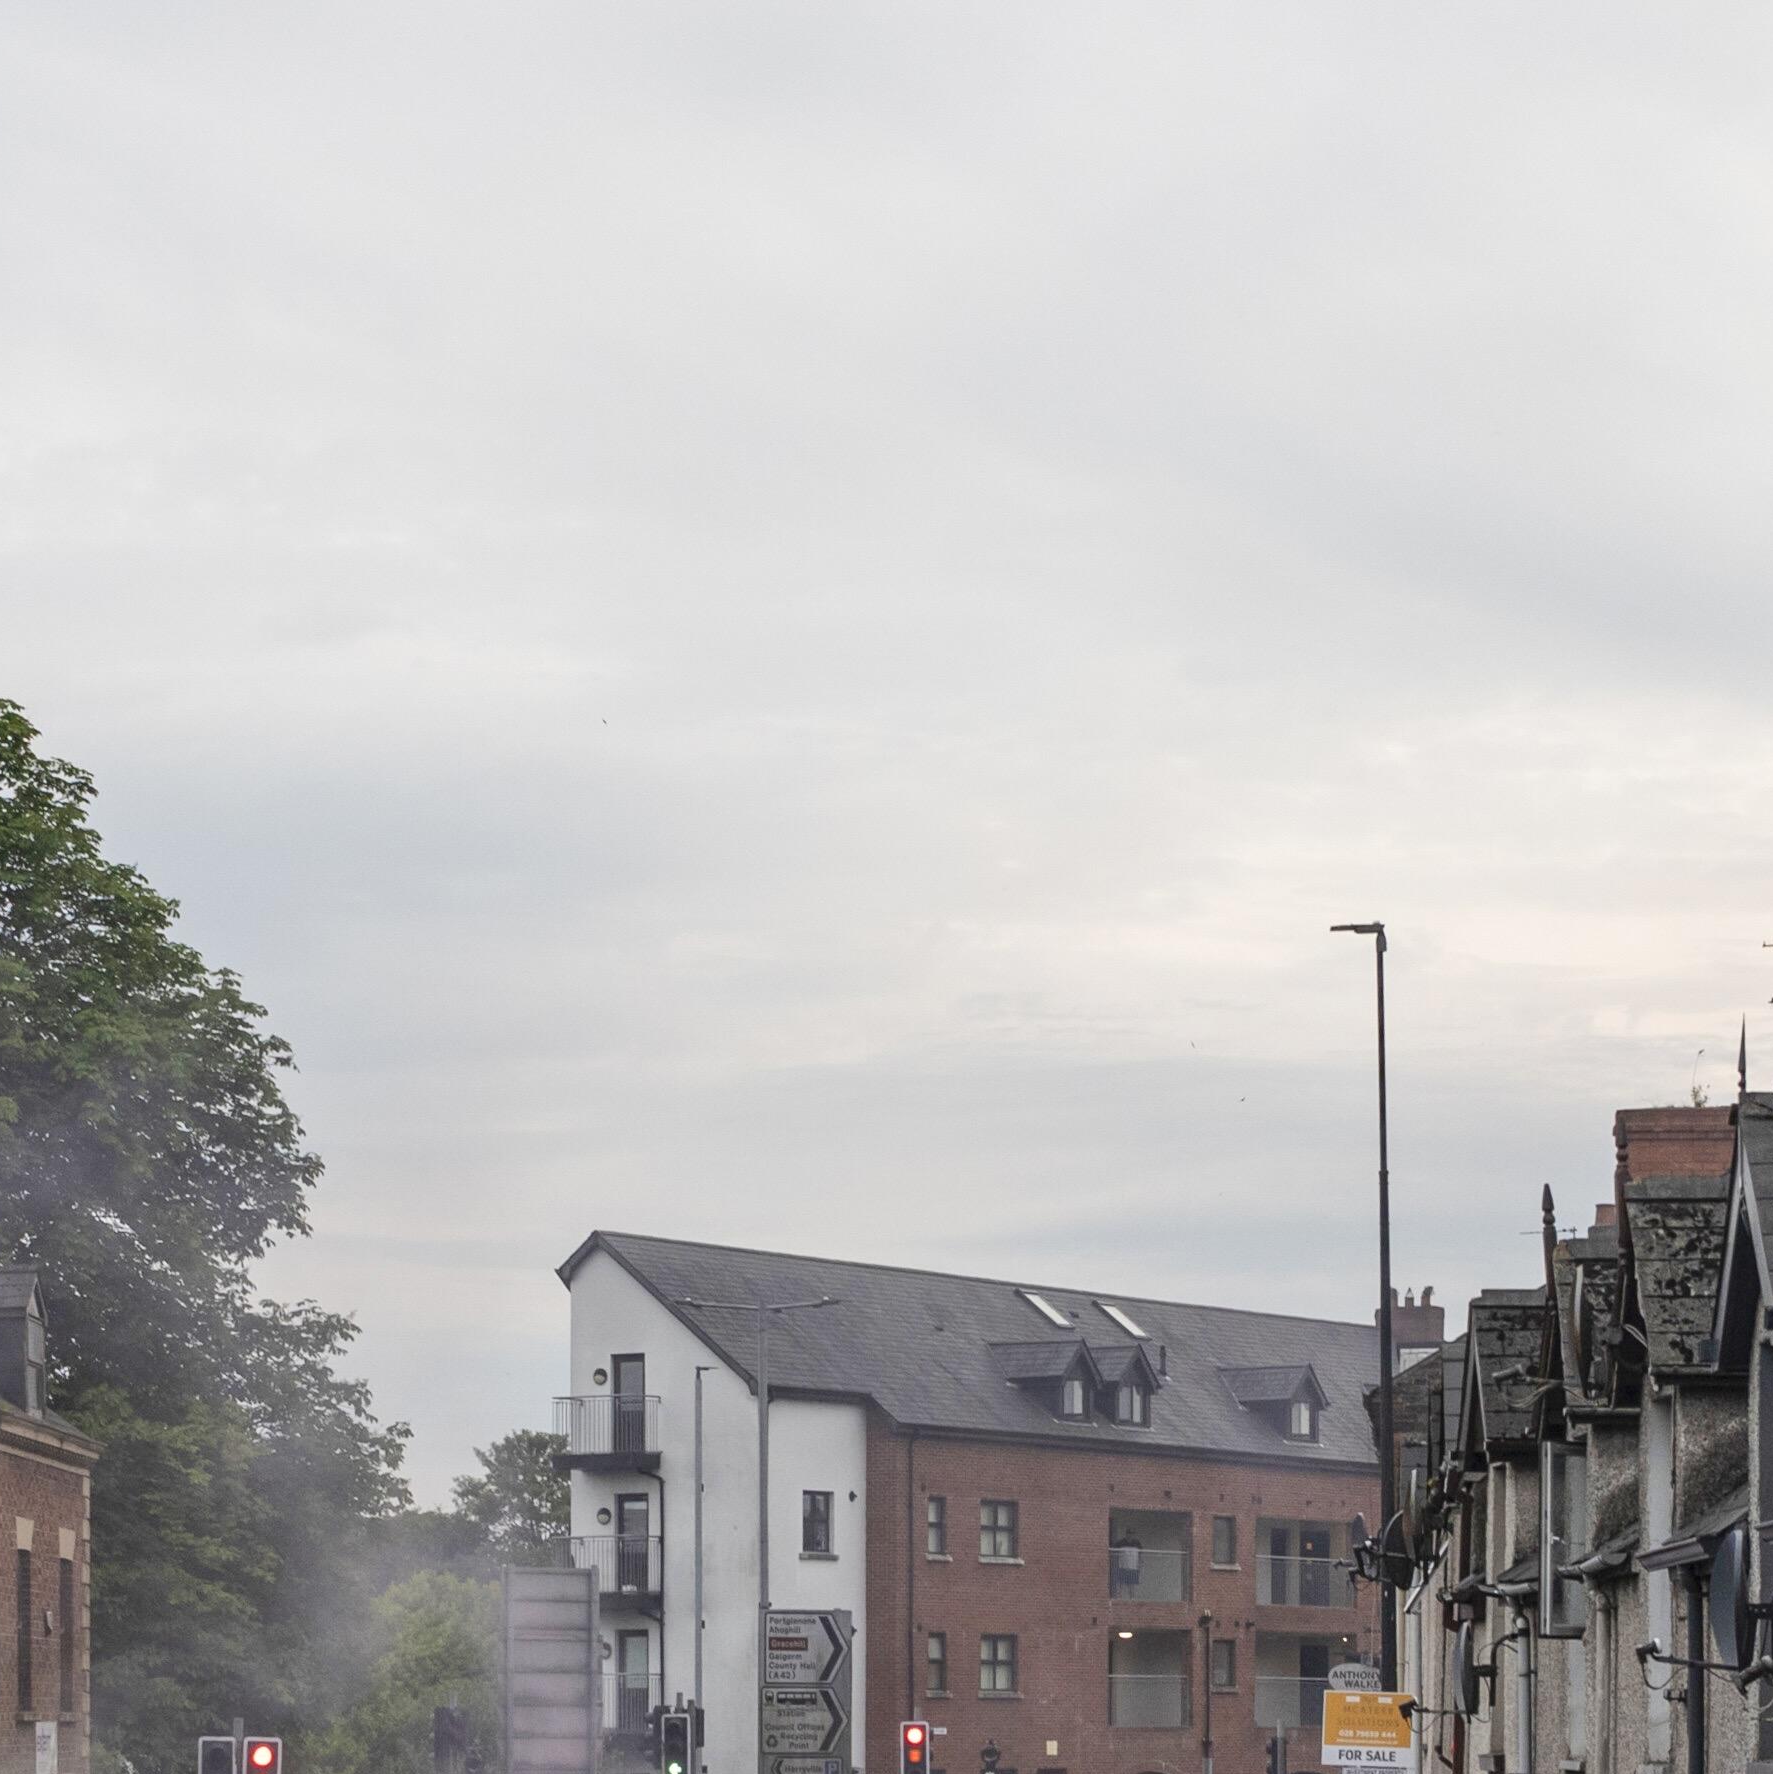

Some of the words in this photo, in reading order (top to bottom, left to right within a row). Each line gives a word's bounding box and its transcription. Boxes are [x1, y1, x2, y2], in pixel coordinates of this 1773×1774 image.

[769, 1662, 797, 1670] County
[769, 1670, 795, 1679] (A42)
[1344, 1679, 1380, 1689] WALKE
[1338, 1749, 1362, 1761] FOR
[1366, 1750, 1396, 1762] SALE
